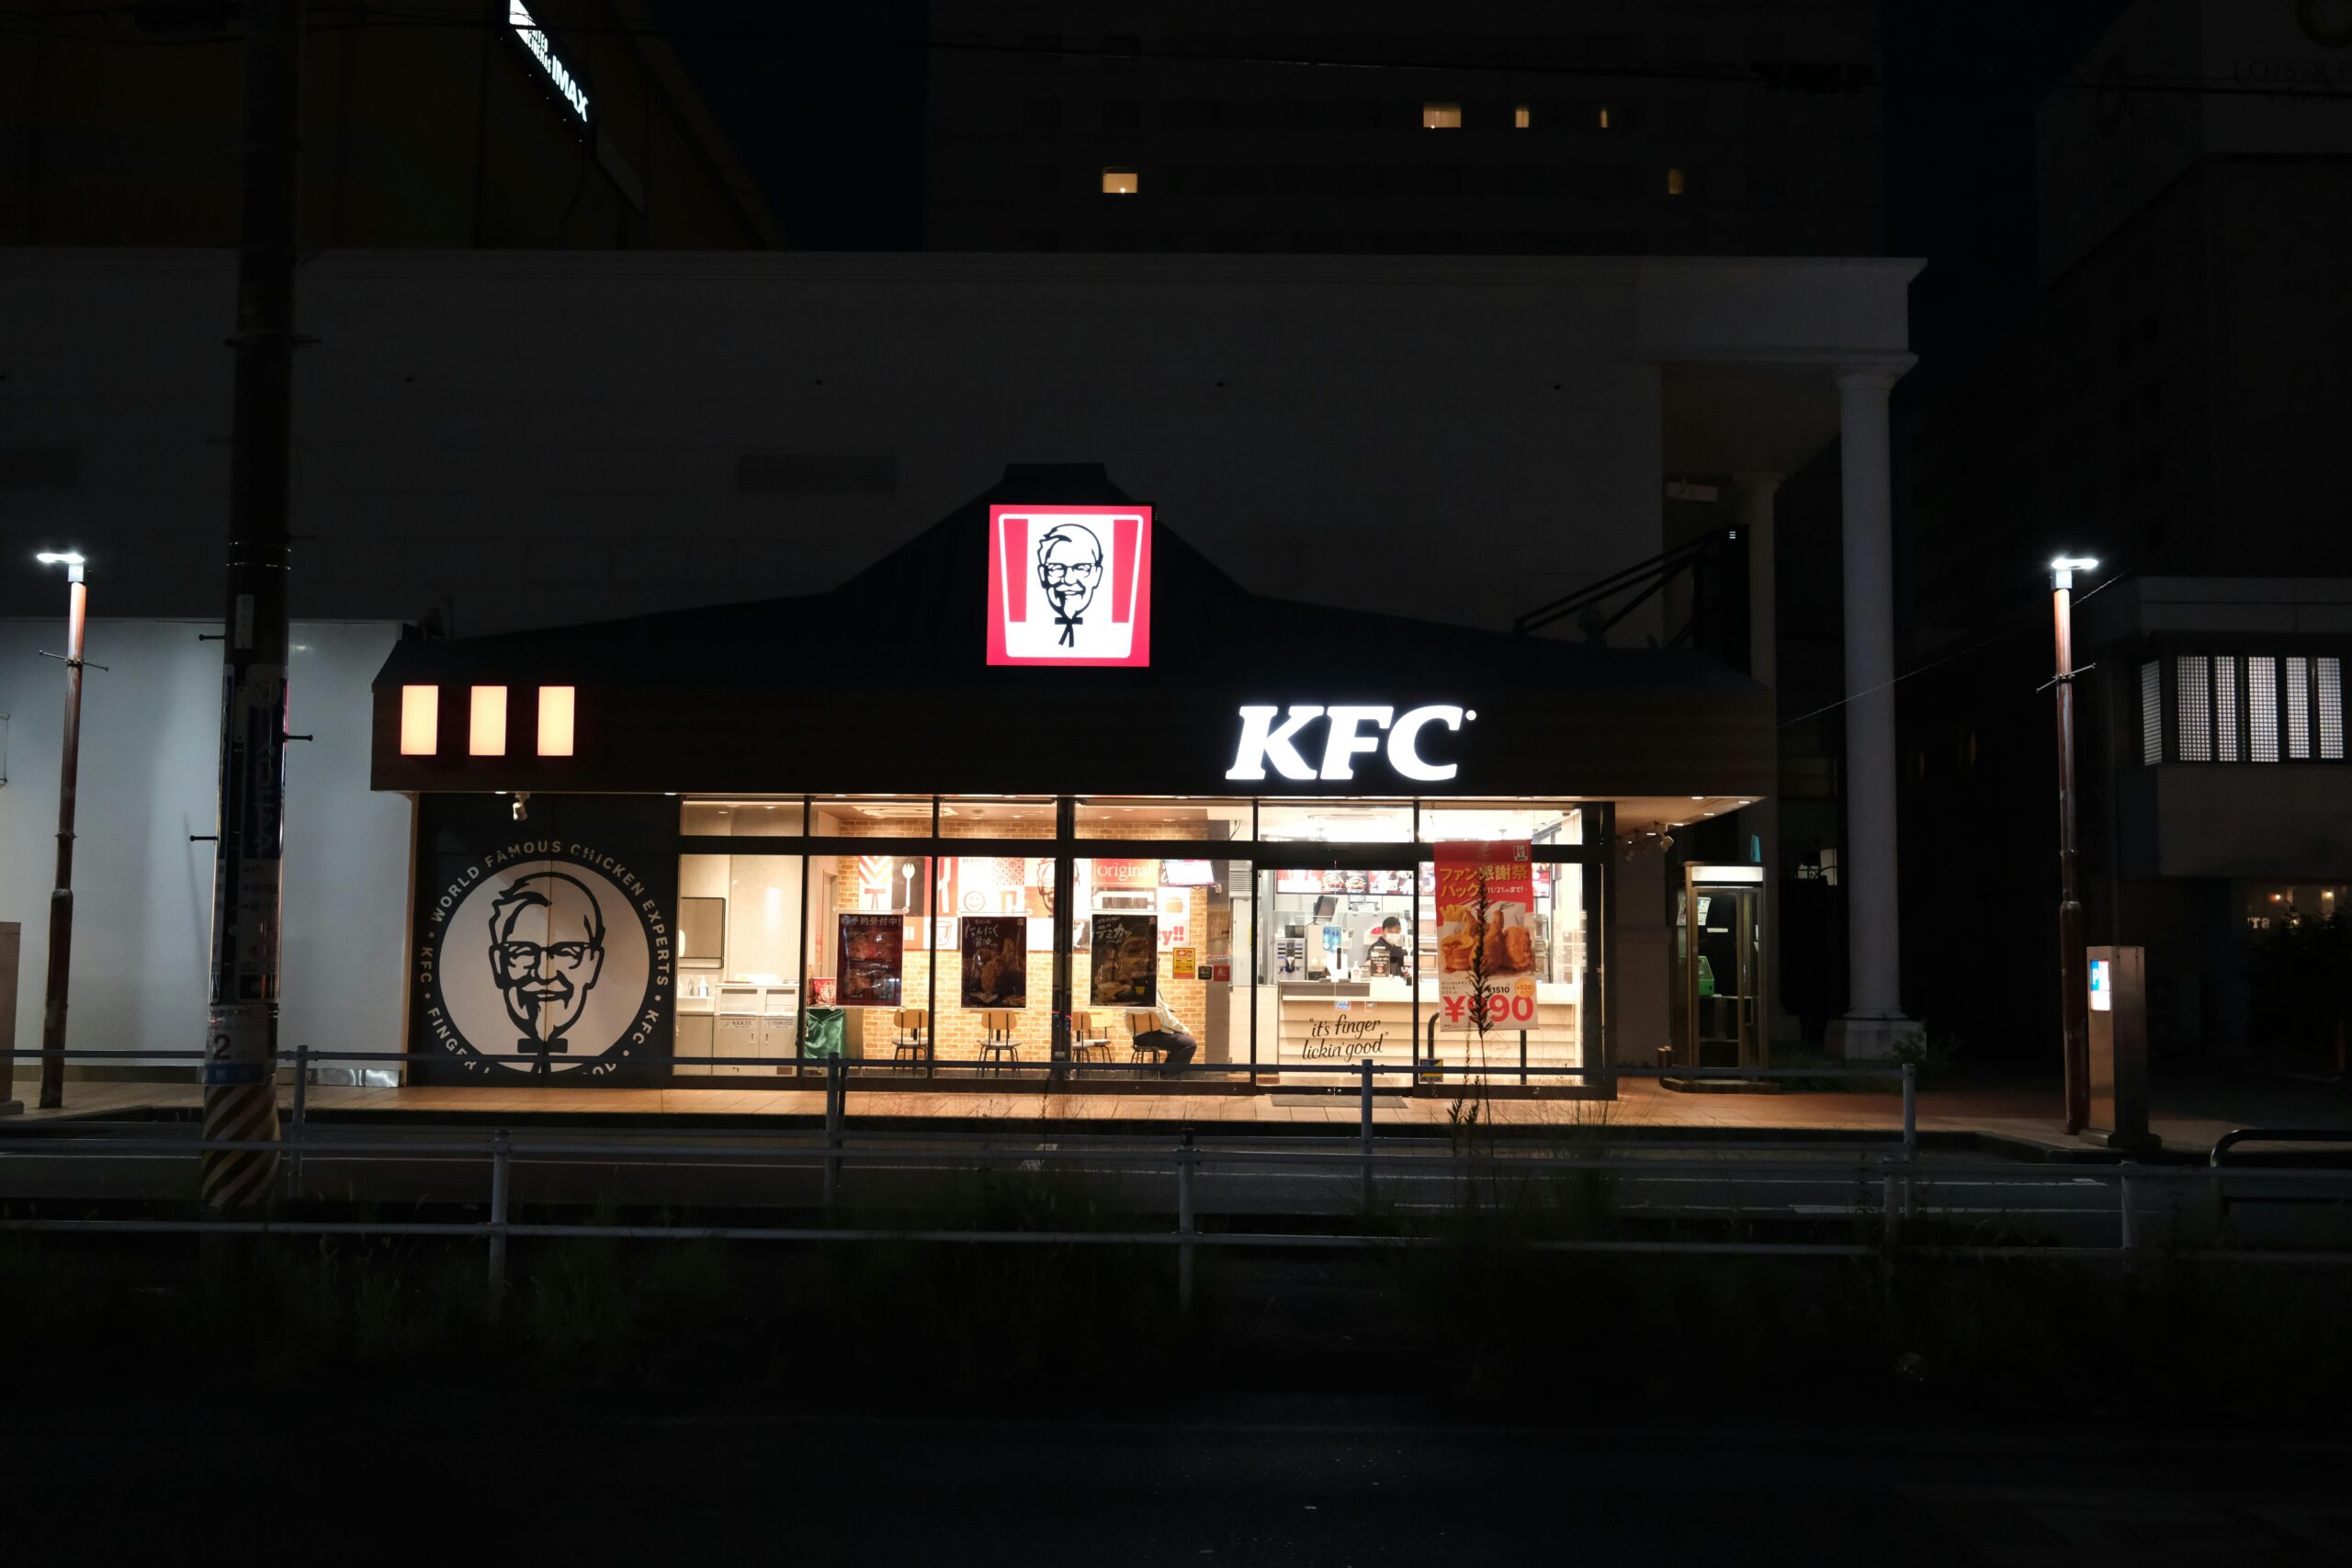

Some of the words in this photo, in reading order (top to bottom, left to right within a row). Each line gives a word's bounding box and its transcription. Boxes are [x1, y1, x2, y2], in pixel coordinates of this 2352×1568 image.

[552, 55, 589, 122] IMAX
[1225, 705, 1464, 782] KFC
[485, 840, 562, 868] FAMOUS
[570, 843, 645, 897] CHICKEN
[432, 864, 480, 923] WORLD
[1441, 882, 1480, 897] パック
[642, 899, 671, 987] EXPERTS
[420, 946, 434, 984] KFC
[632, 1009, 661, 1045] KFC
[1334, 1013, 1381, 1040] finger
[213, 1033, 232, 1060] 2
[1302, 1038, 1344, 1060] lickin'
